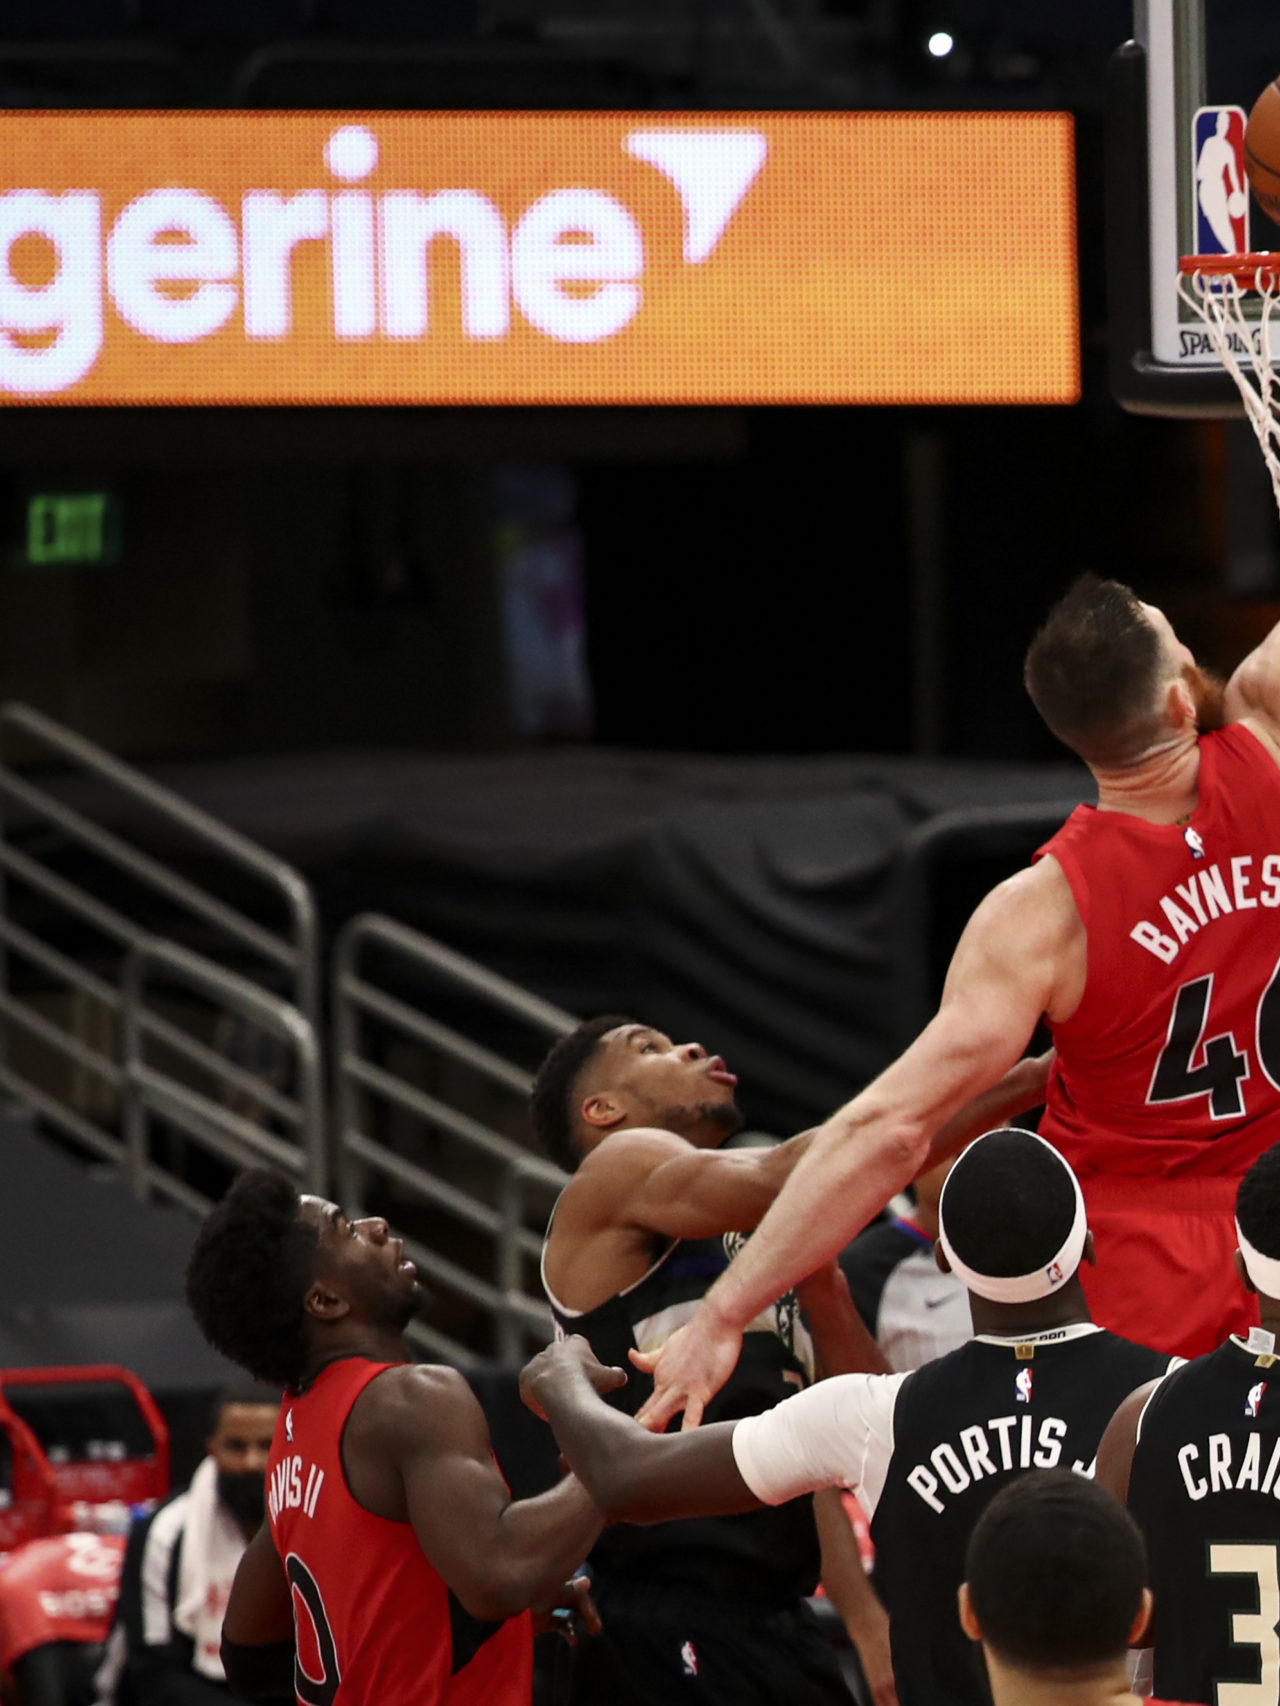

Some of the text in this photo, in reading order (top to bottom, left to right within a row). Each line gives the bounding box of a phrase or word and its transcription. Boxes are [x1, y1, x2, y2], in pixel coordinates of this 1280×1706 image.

[0, 124, 646, 398] gerine
[905, 1414, 1068, 1515] PORTIS
[285, 1551, 342, 1706] 0
